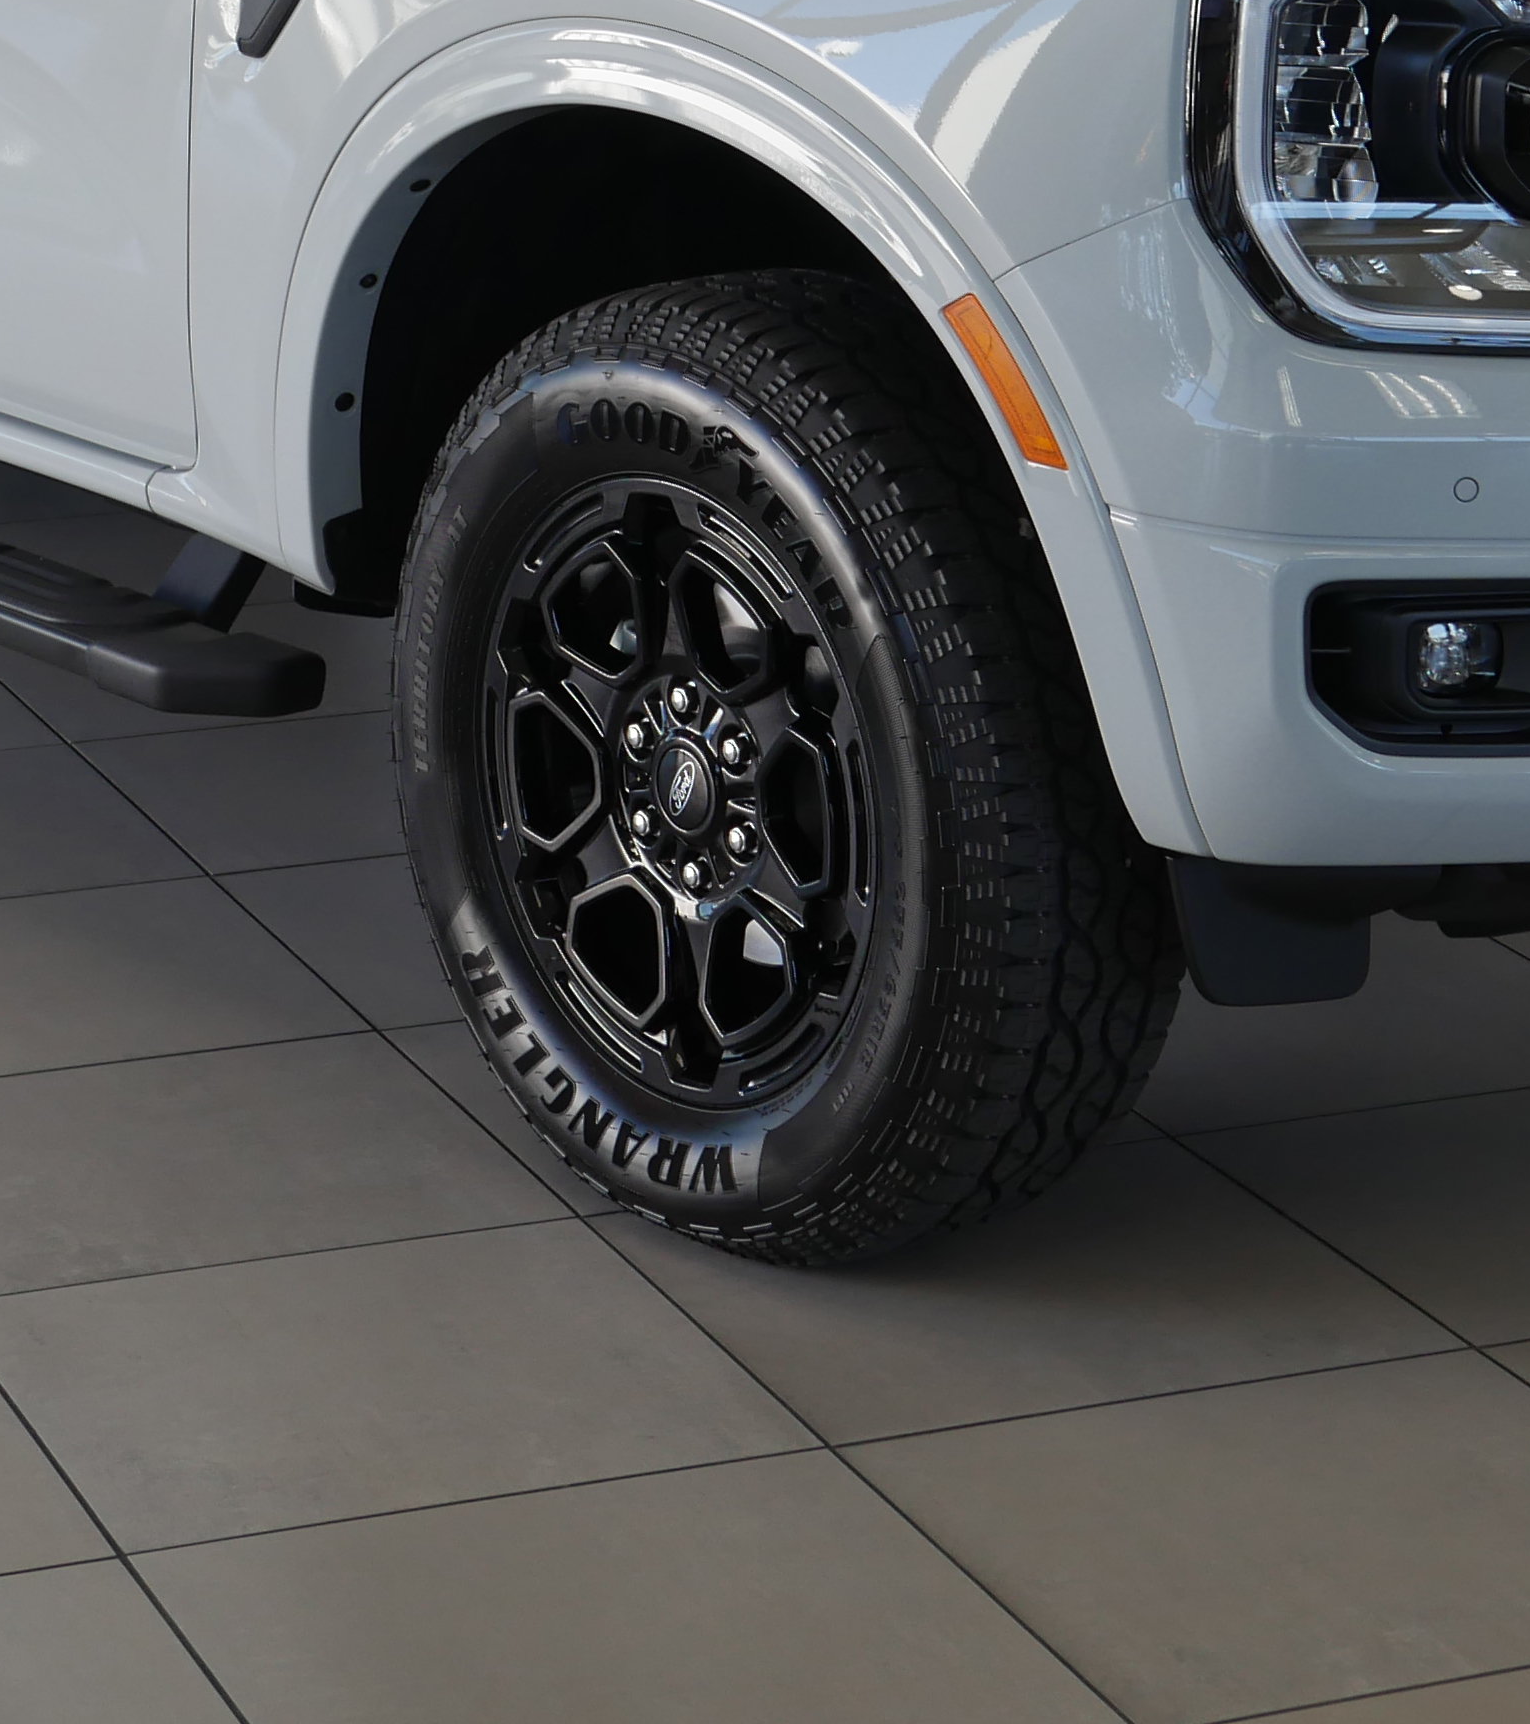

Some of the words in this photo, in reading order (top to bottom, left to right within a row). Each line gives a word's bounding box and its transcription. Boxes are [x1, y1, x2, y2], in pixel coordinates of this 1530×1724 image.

[557, 398, 854, 629] GOODYEAR
[414, 560, 446, 773] TERRITORY
[672, 769, 692, 810] Ford
[461, 945, 738, 1194] WRANGLER
